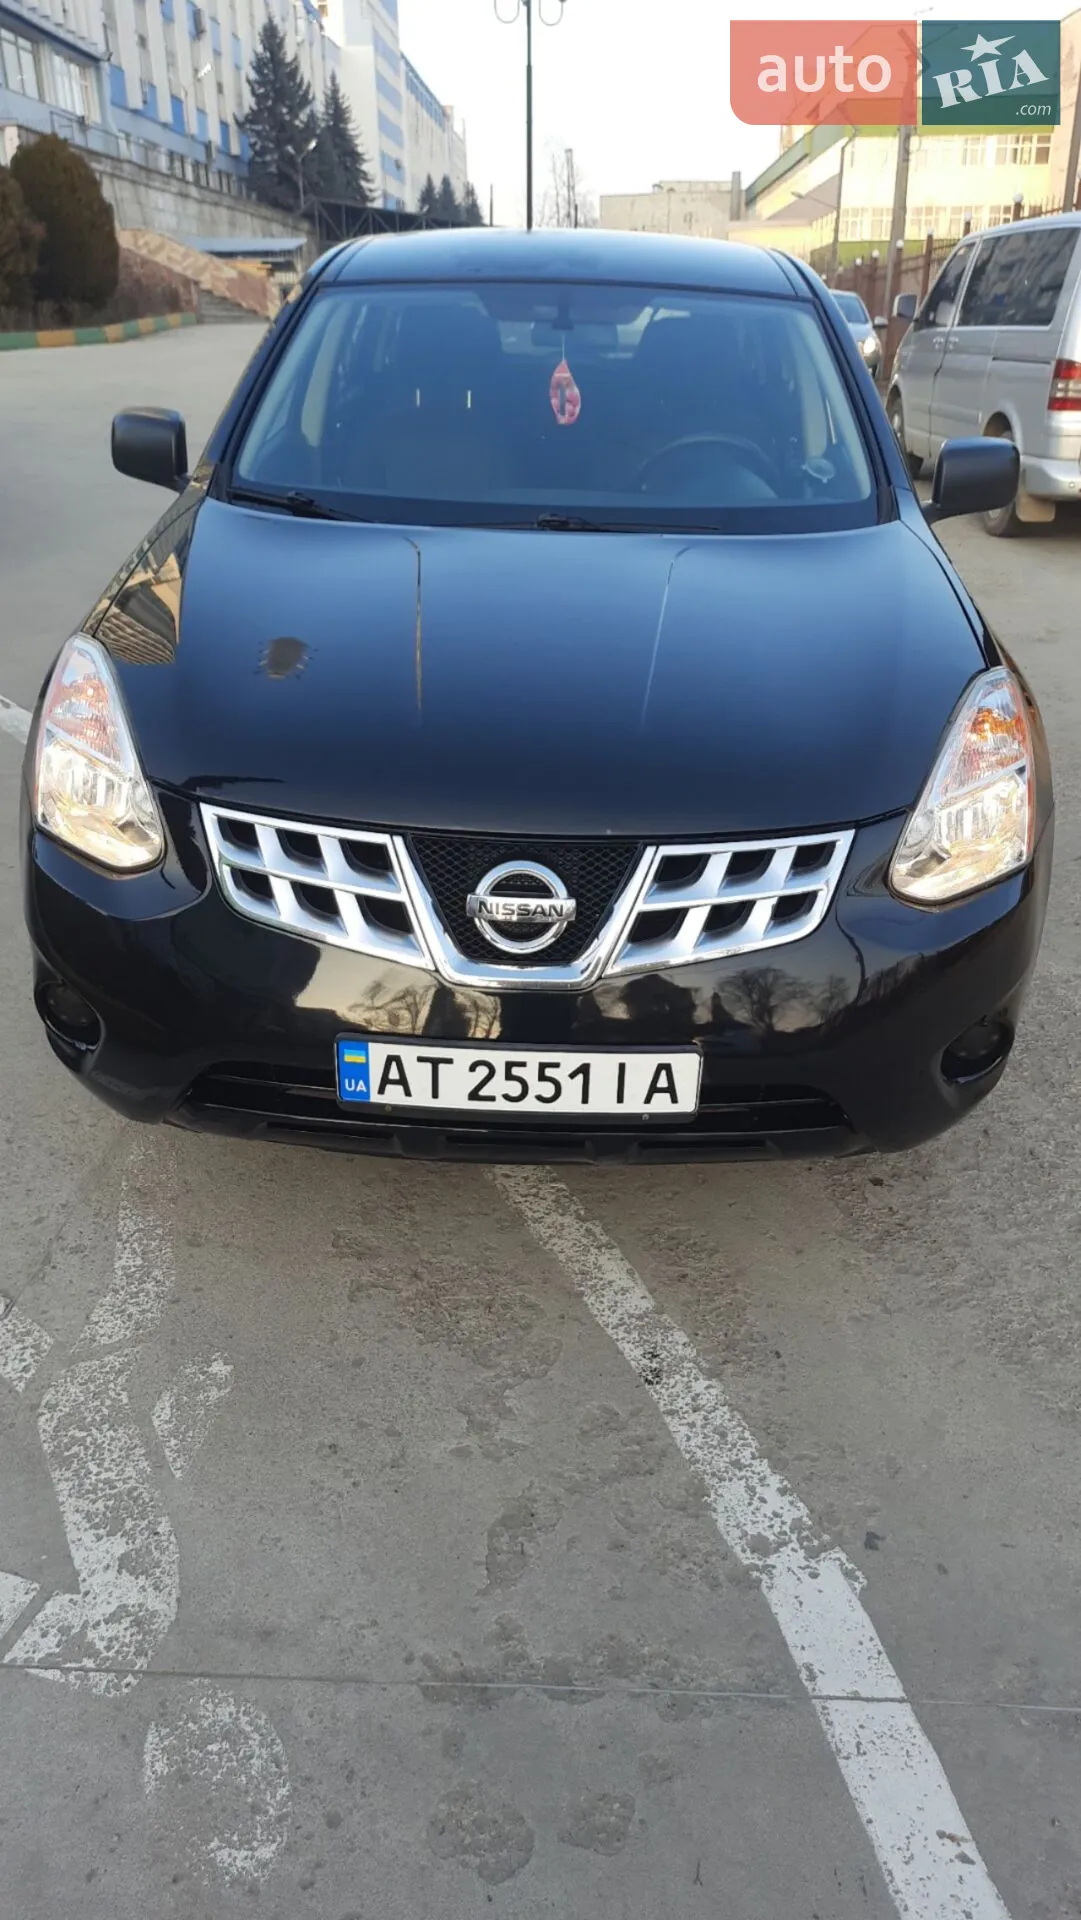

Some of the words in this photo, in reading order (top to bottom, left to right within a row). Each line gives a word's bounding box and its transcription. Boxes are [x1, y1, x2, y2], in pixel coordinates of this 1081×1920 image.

[478, 900, 564, 917] NISSAN
[344, 1078, 367, 1093] UA
[377, 1054, 454, 1099] AT
[467, 1059, 591, 1104] 2551
[616, 1062, 679, 1104] IA
